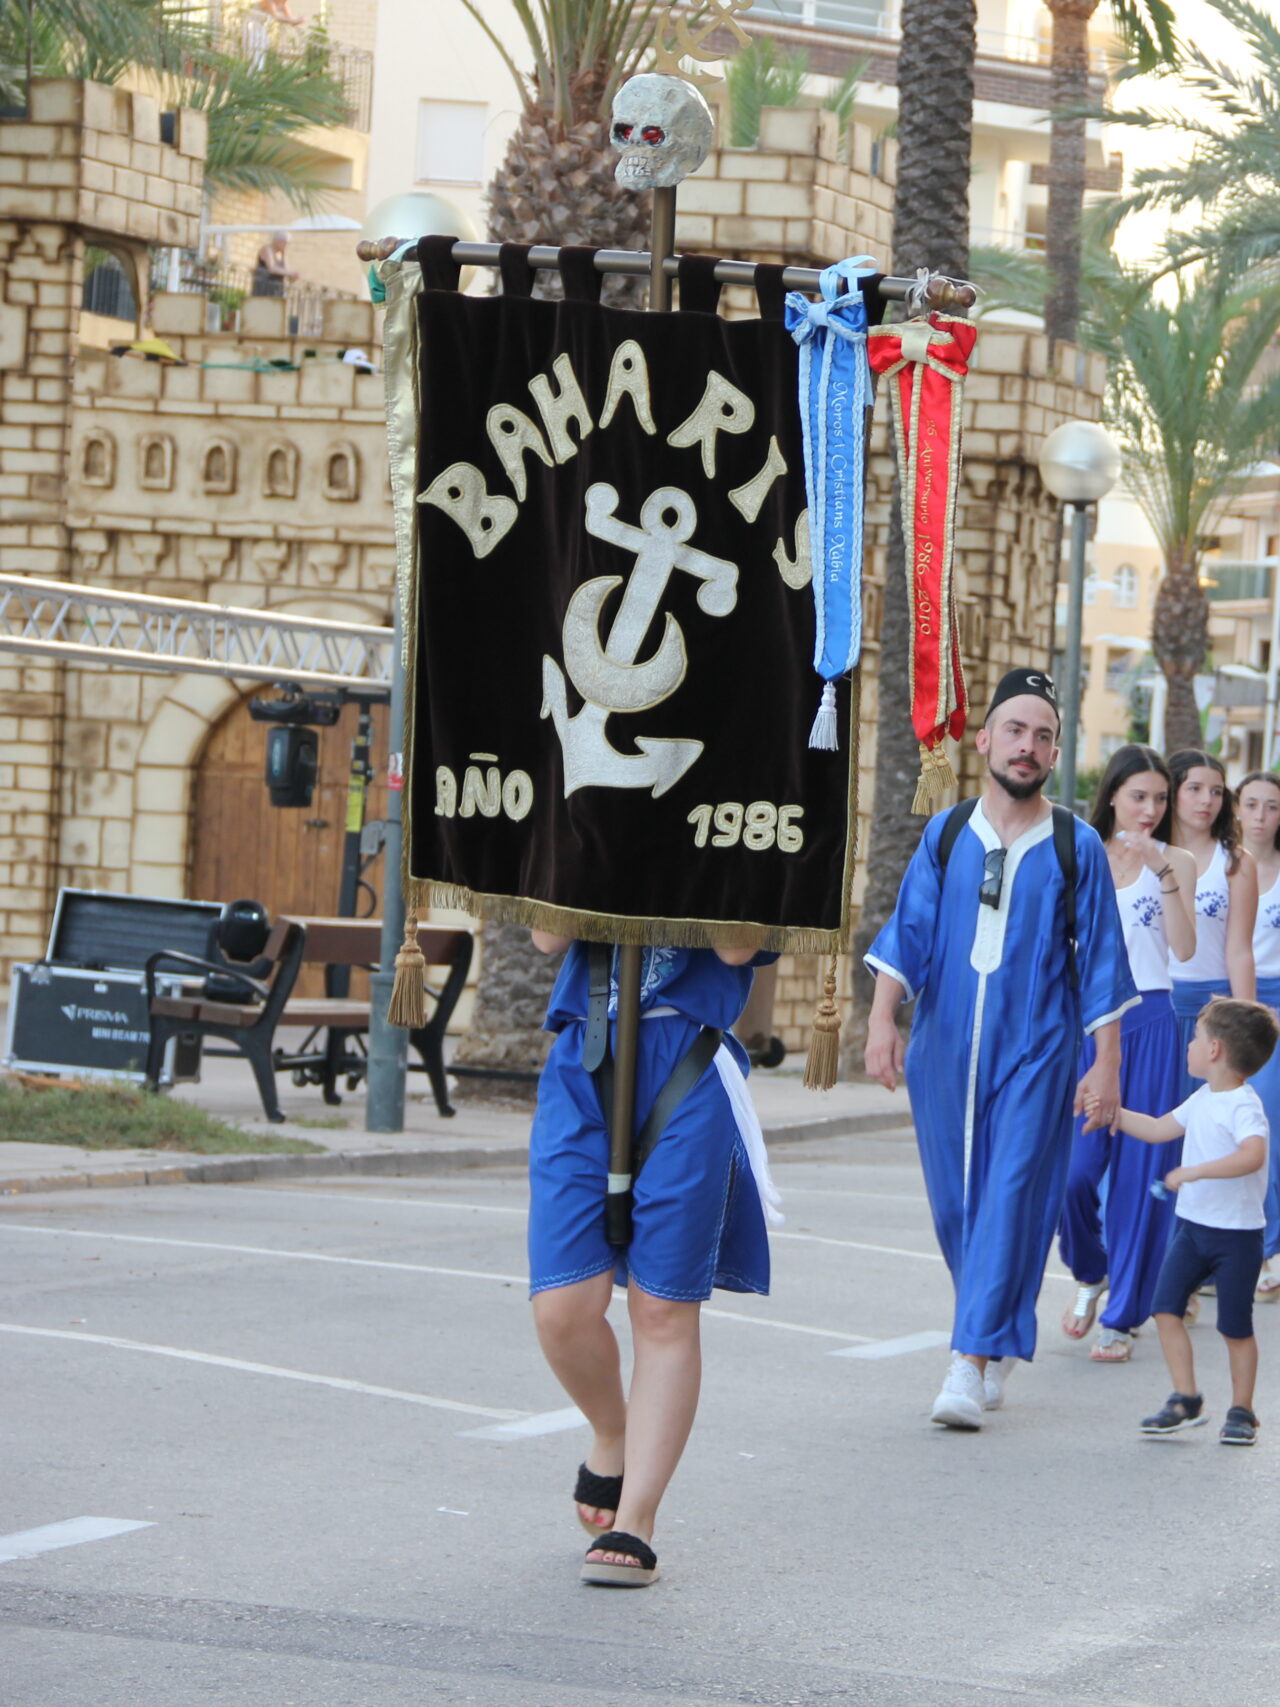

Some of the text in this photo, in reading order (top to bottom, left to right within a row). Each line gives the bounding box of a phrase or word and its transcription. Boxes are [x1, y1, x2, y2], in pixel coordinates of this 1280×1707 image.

[831, 381, 848, 437] Moros
[831, 454, 848, 528] Cristians
[919, 440, 933, 524] Aniversario
[434, 752, 534, 822] AÑO
[687, 800, 804, 853] 1986
[77, 1007, 128, 1024] PRISMA
